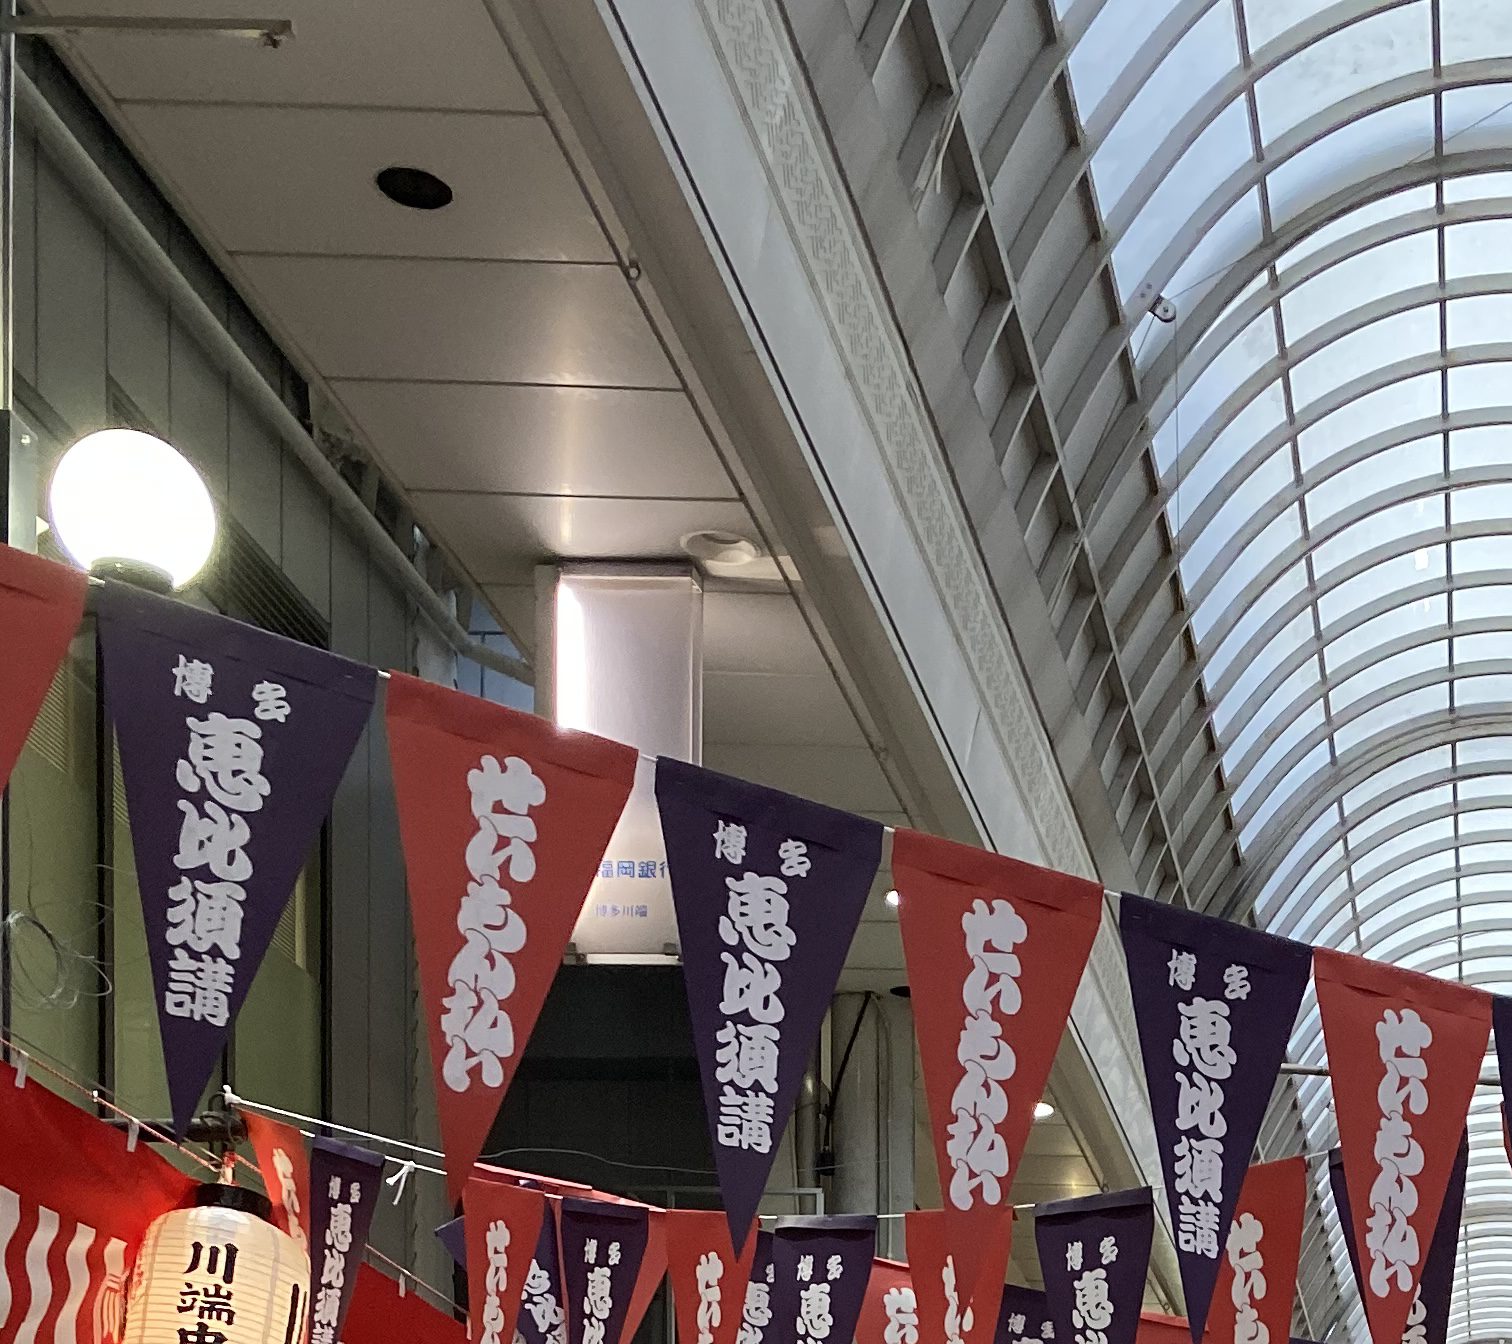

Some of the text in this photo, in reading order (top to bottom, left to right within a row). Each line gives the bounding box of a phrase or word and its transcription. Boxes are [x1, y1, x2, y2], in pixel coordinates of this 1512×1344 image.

[172, 655, 290, 722] 博多
[166, 712, 270, 1026] 恵比須講
[713, 820, 811, 877] 博多
[441, 755, 546, 1092] せいもん払い
[1167, 949, 1251, 1000] 博多
[716, 872, 796, 1153] 恵比須講
[947, 899, 1027, 1210] せいもん払い
[1173, 997, 1237, 1258] 恵比須講
[1366, 1009, 1432, 1298] せいもん払い
[585, 1238, 621, 1265] 博多
[797, 1255, 843, 1281] 博多
[1066, 1236, 1118, 1271] 博多
[1008, 1313, 1054, 1338] 博多
